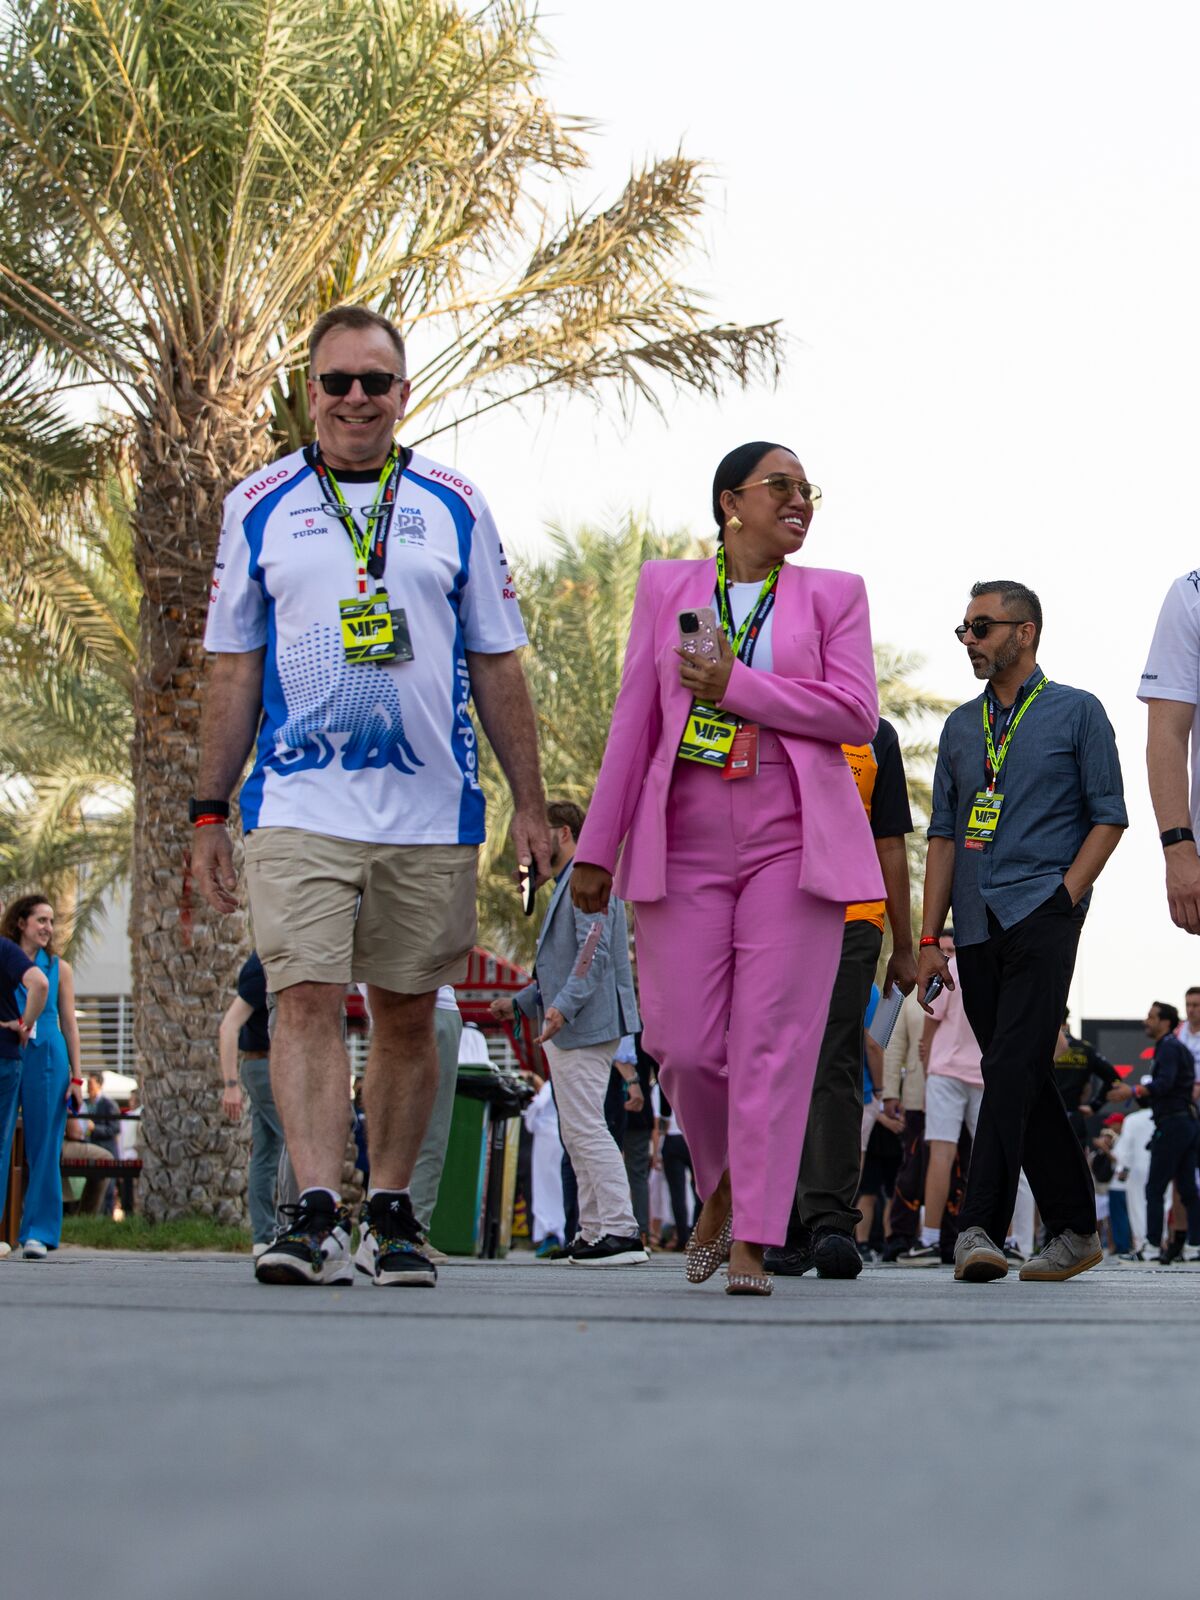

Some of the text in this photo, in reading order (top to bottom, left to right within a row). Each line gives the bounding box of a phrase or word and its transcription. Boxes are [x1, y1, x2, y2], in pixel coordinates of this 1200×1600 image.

[244, 470, 288, 500] HUGO
[430, 469, 473, 496] HUGO
[400, 506, 421, 515] VISA
[292, 528, 328, 539] TUDOR
[346, 618, 388, 637] VIP
[694, 720, 732, 743] VIP
[975, 809, 998, 824] VIP
